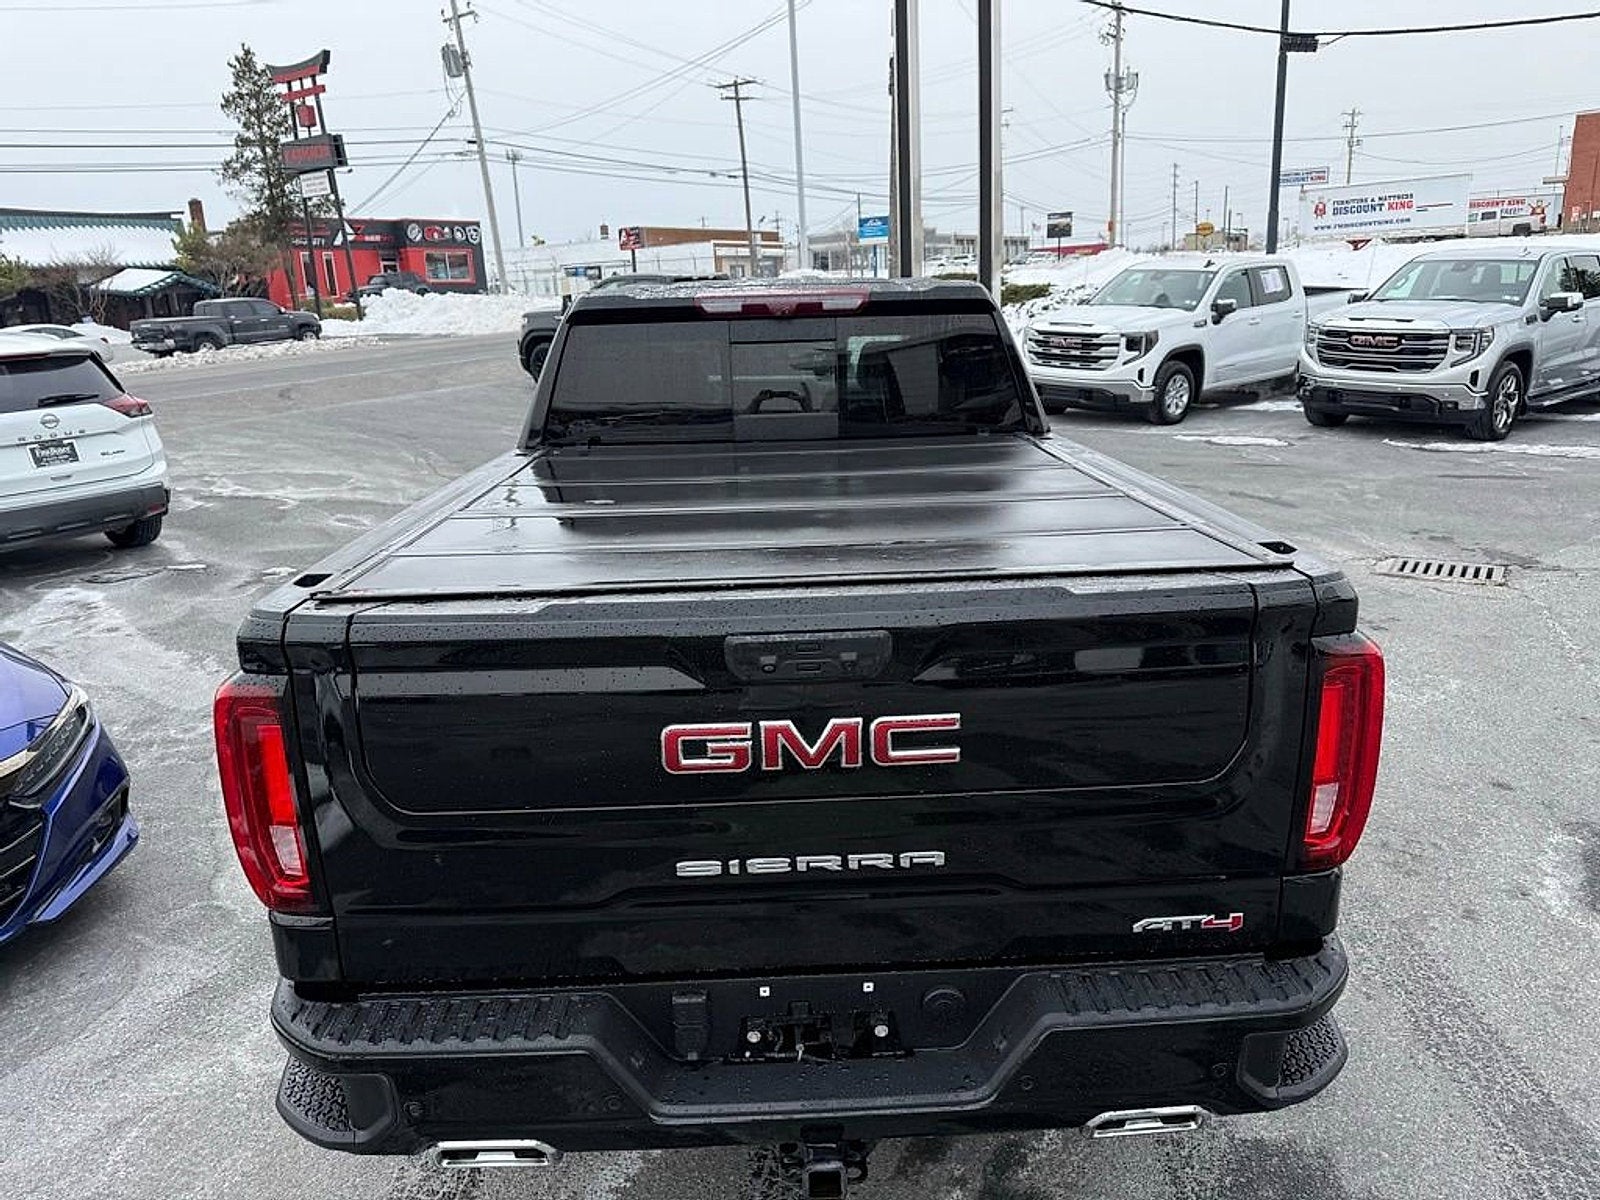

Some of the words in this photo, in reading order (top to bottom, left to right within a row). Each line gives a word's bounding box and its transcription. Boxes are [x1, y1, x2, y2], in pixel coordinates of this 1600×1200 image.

[1333, 203, 1384, 216] DISCOUNT
[1387, 200, 1413, 211] KING
[1469, 200, 1505, 209] DISCOUNT
[1507, 198, 1526, 206] KING
[1050, 336, 1083, 348] GMC
[1350, 334, 1399, 347] GMC
[18, 429, 85, 441] ROGUE
[661, 712, 961, 775] GMC
[675, 851, 945, 877] SIERRA
[1132, 912, 1244, 933] AT4
